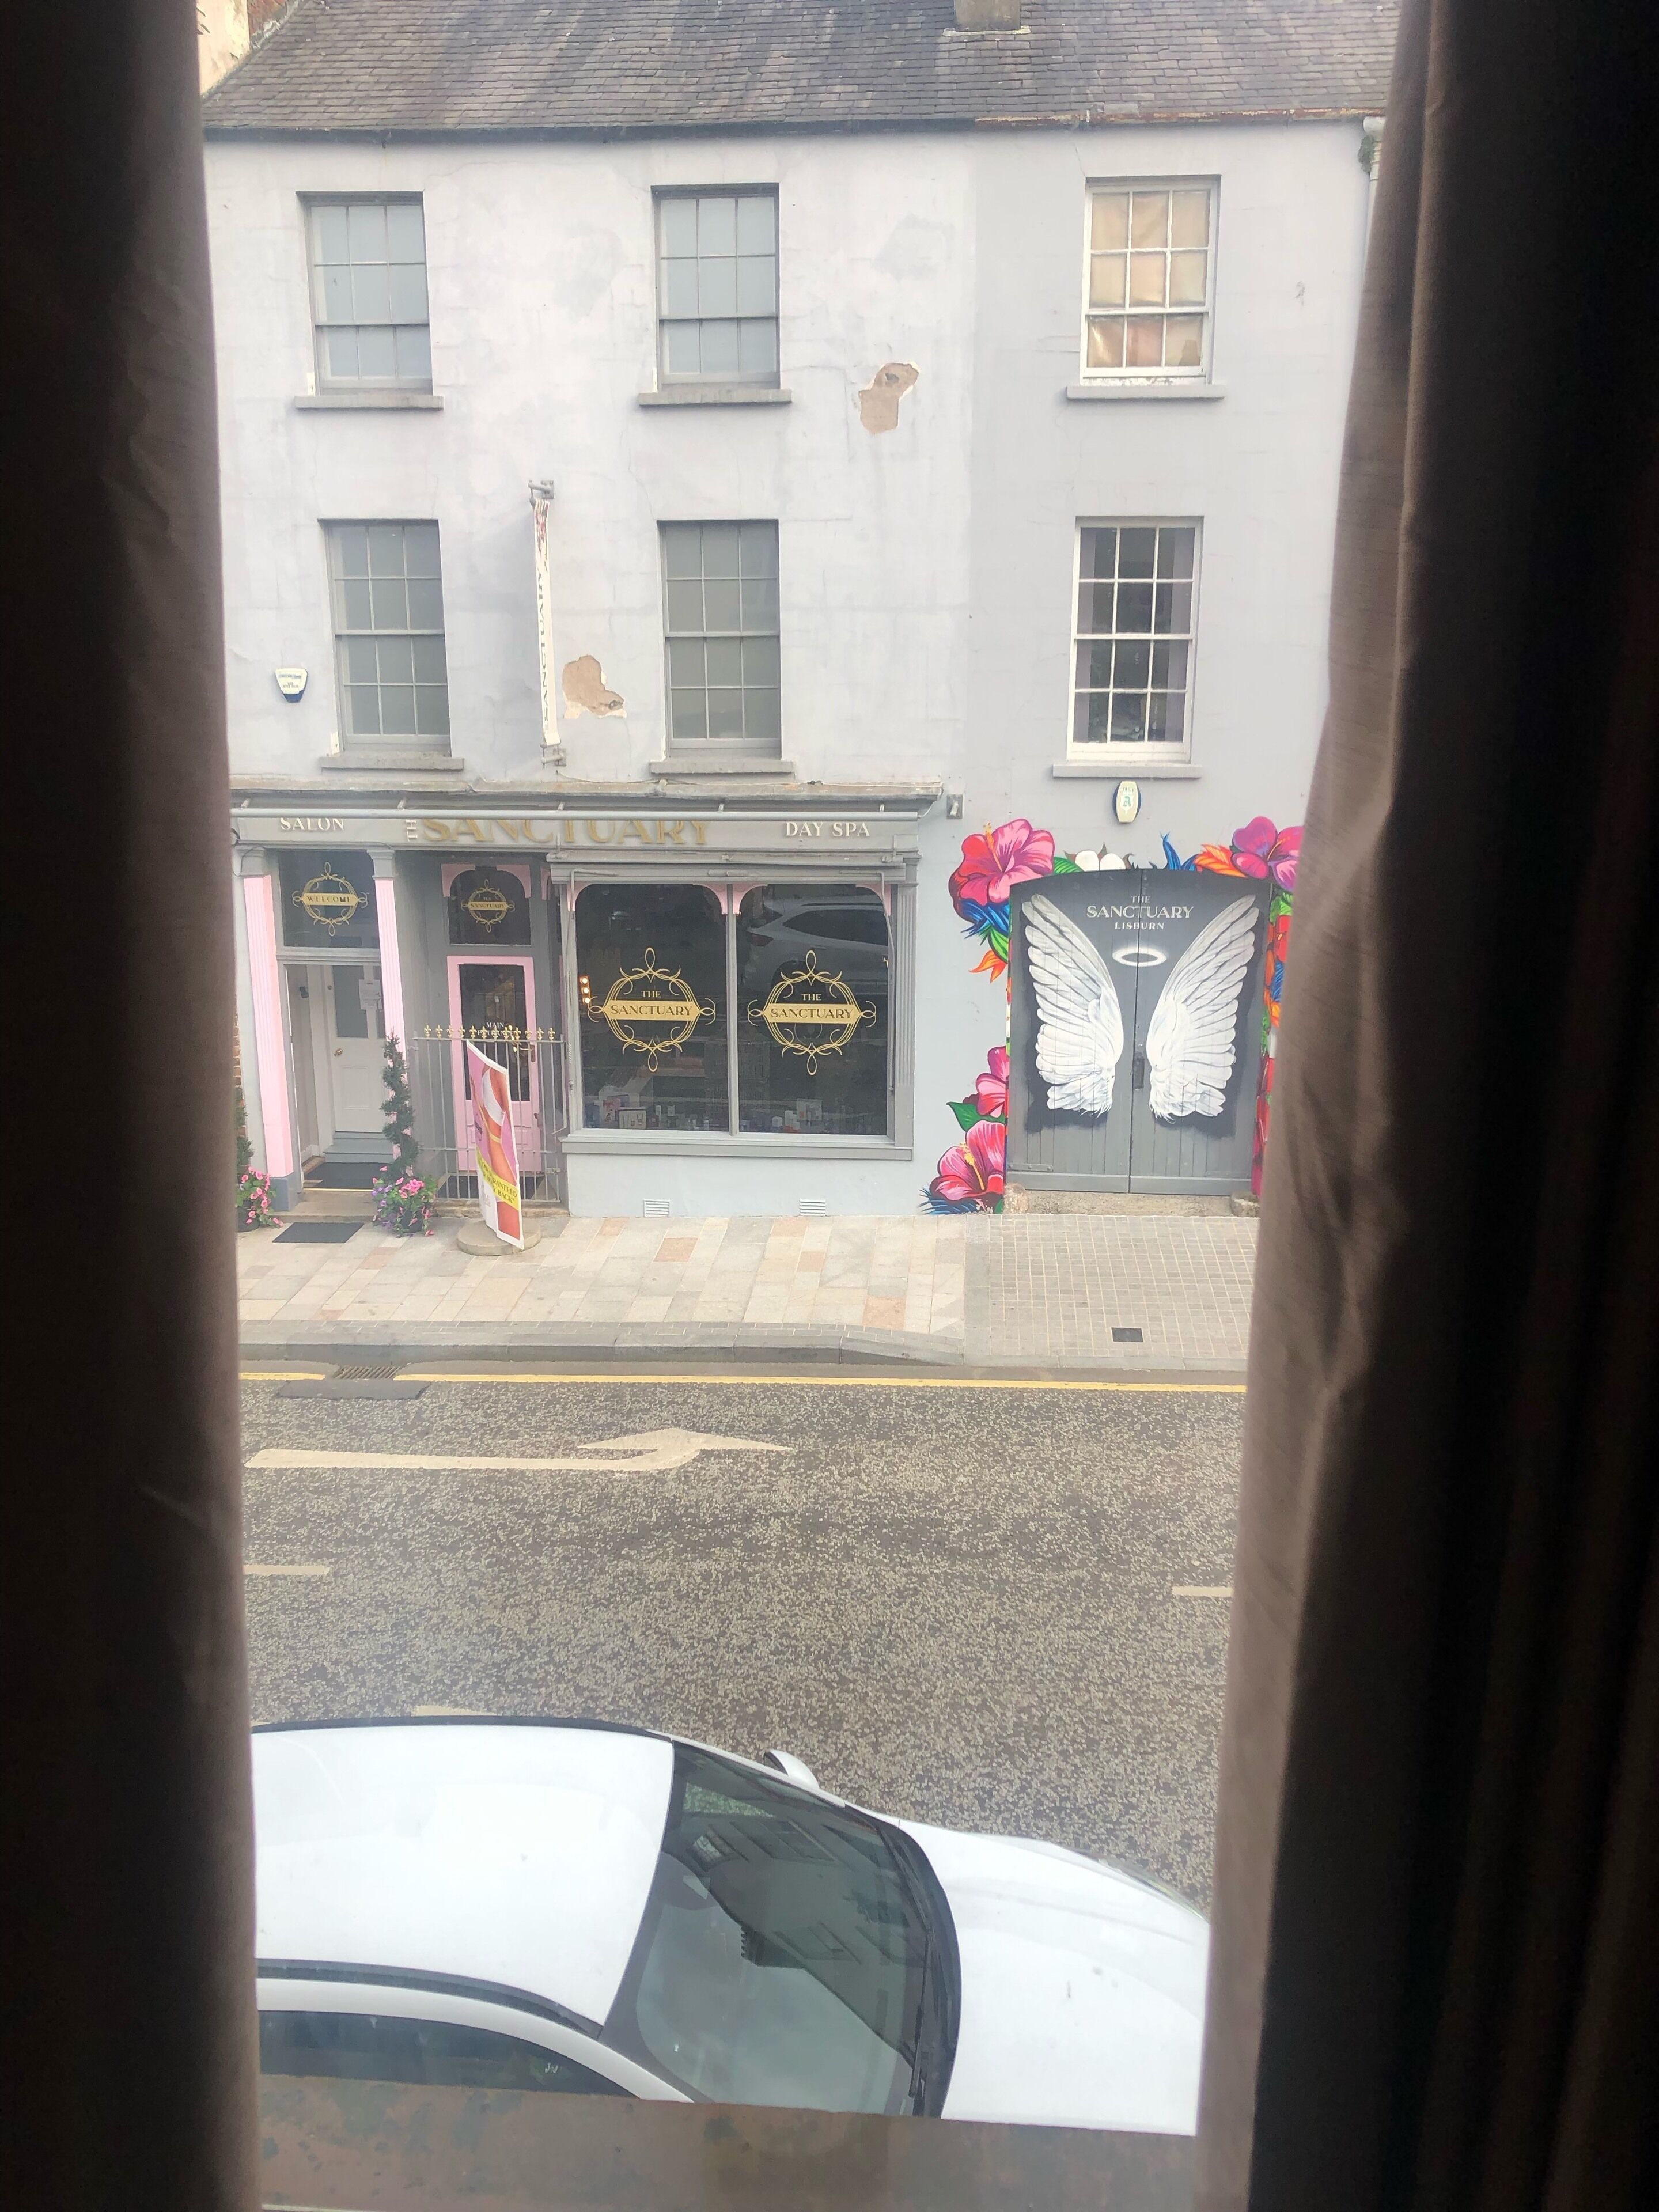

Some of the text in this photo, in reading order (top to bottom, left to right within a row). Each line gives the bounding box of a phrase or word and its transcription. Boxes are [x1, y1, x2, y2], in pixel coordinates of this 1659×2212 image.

[281, 817, 344, 831] SALON
[786, 821, 870, 837] DAY SPA
[406, 819, 709, 844] TH SANCTUARY
[1086, 905, 1194, 919] SANCTUARY
[1115, 922, 1165, 930] LISBURN
[641, 990, 662, 998] THE
[801, 993, 822, 1001] THE
[611, 1005, 692, 1016] SANCTUARY
[770, 1008, 853, 1018] SANCTUARY
